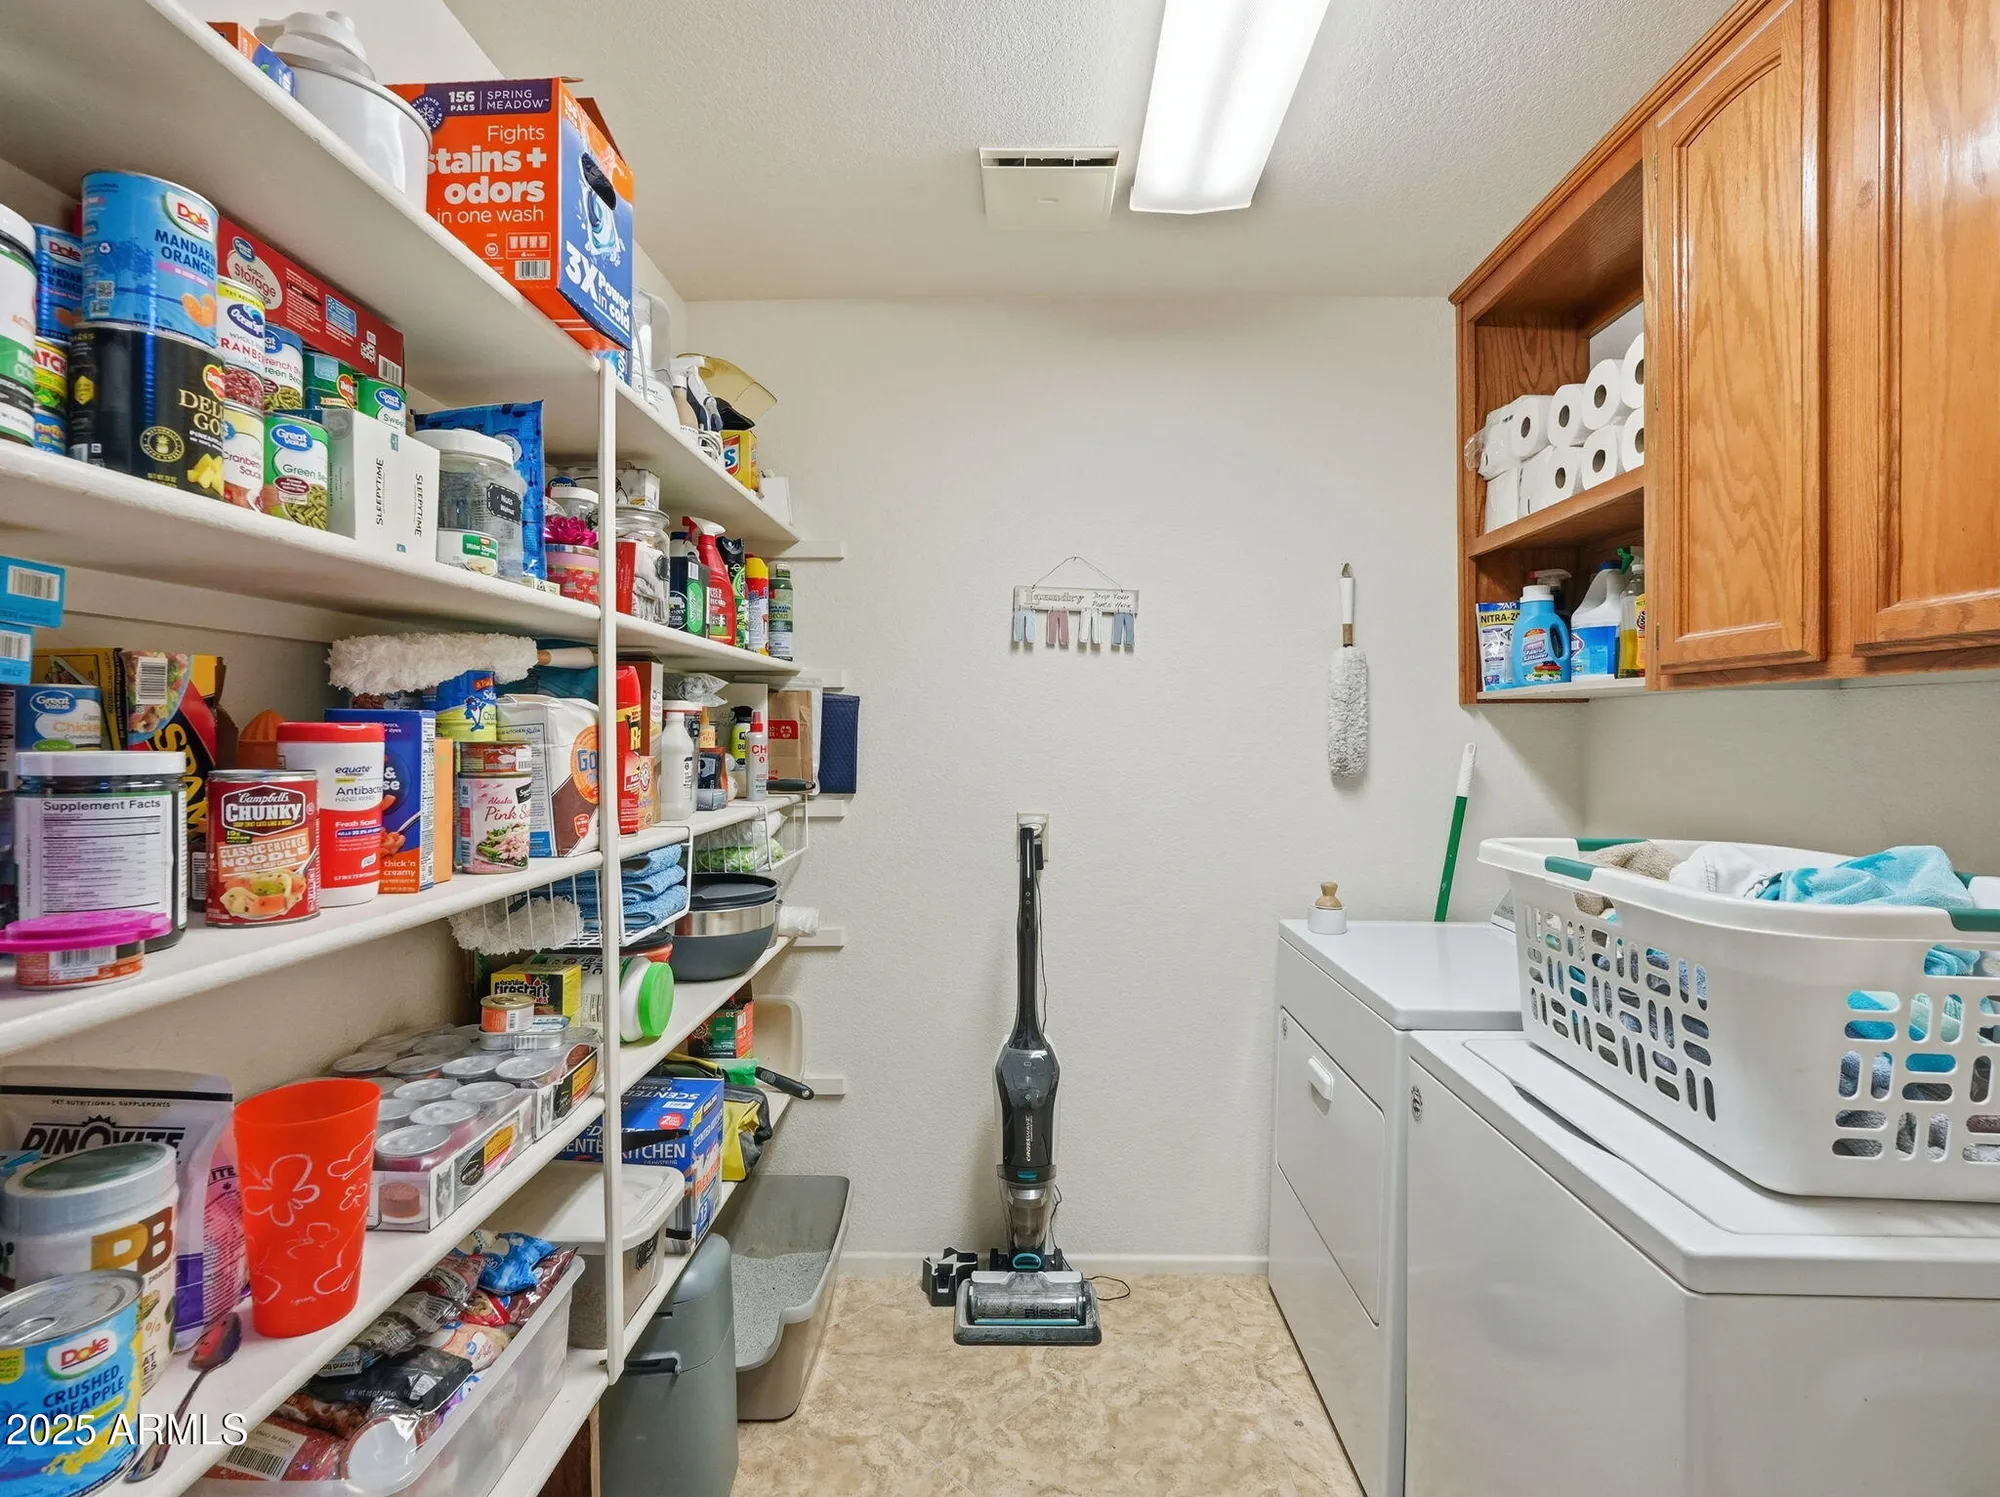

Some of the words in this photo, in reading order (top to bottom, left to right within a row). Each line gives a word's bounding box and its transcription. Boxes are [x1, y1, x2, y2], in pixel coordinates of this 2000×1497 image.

[448, 91, 475, 103] 156
[487, 90, 532, 99] SPRING
[487, 125, 545, 144] Fights
[426, 146, 521, 175] stains
[444, 176, 545, 204] odors
[177, 202, 209, 230] Dole
[437, 208, 452, 224] in
[457, 210, 492, 224] one
[496, 205, 544, 223] wash
[48, 240, 81, 260] Dole
[161, 246, 215, 280] ORANGES
[234, 263, 276, 298] Storage
[609, 303, 630, 332] cold
[264, 366, 287, 378] reen
[265, 358, 292, 372] rench
[193, 412, 222, 436] GO
[276, 427, 308, 442] Great
[282, 463, 317, 480] Green
[375, 457, 384, 526] SLEEPYTIME
[415, 473, 424, 537] SLEEPYTIME
[36, 695, 70, 706] Great
[335, 765, 371, 777] equate
[384, 766, 397, 779] &
[383, 780, 401, 791] se
[43, 801, 124, 814] Supplement
[129, 799, 161, 810] Facts
[225, 803, 302, 822] CHUNKY
[484, 805, 516, 823] Pink
[220, 842, 266, 859] CLASSIC
[267, 835, 308, 852] CHICKEN
[221, 845, 308, 868] NOODLE
[383, 867, 415, 877] creamy
[384, 859, 407, 868] thick
[51, 1098, 65, 1106] PET
[66, 1099, 117, 1107] NUTRITIONAL
[118, 1100, 171, 1109] SUPPLEMENTS
[210, 1166, 237, 1182] ITE
[60, 1336, 109, 1366] Dole
[43, 1364, 120, 1408] CRUSHED
